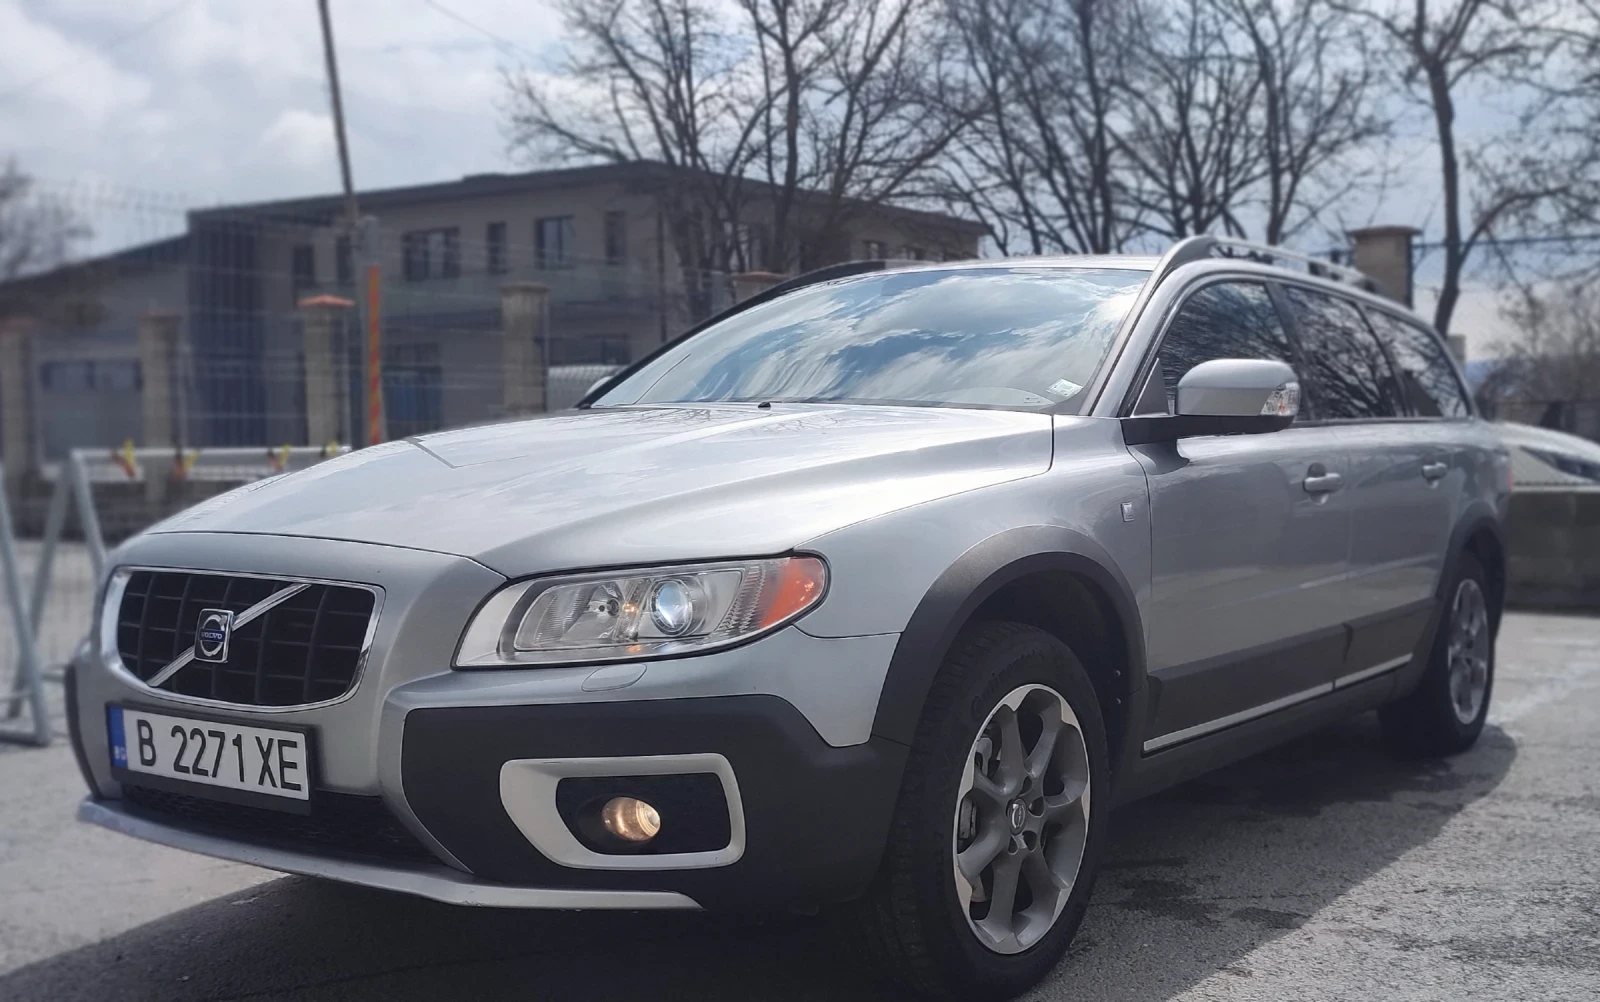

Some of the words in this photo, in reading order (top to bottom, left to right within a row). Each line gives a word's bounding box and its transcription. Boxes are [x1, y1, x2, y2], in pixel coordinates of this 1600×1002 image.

[201, 631, 223, 640] VOLVO
[137, 719, 156, 767] B
[170, 725, 244, 783] 2271
[255, 735, 302, 792] XE
